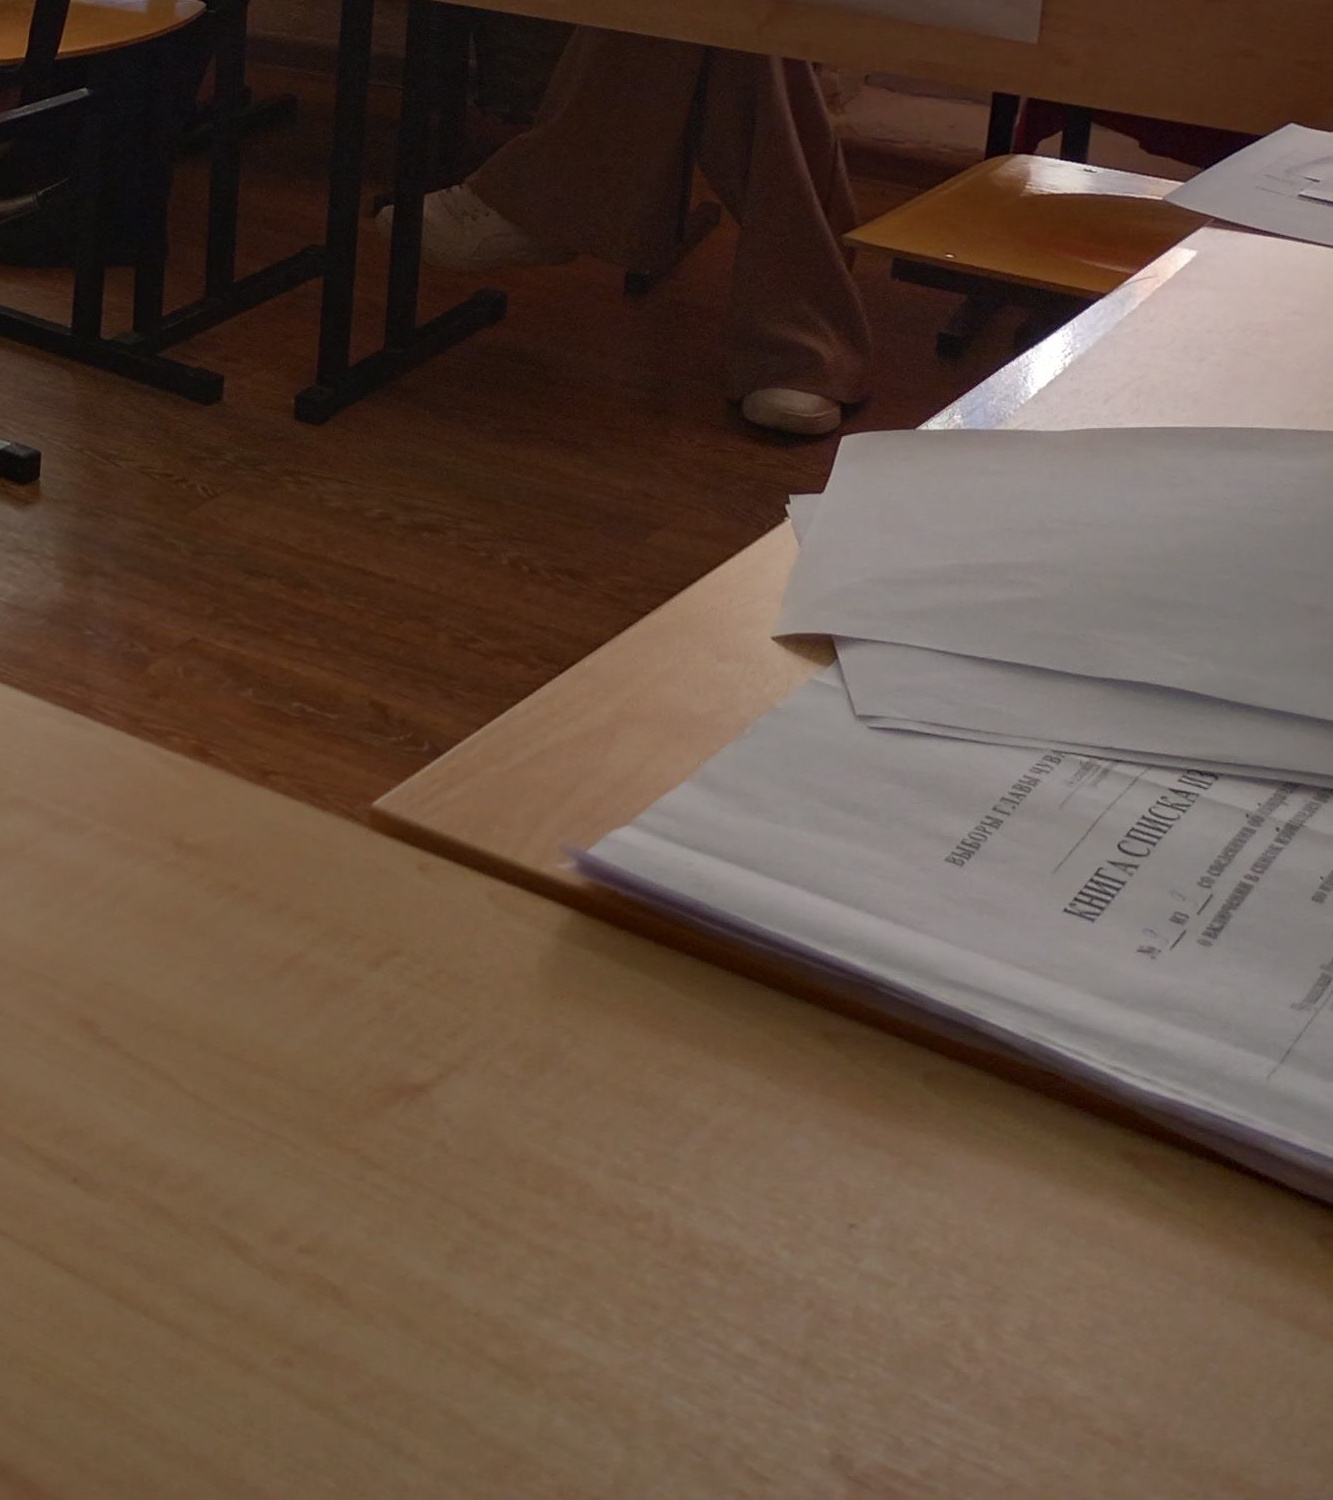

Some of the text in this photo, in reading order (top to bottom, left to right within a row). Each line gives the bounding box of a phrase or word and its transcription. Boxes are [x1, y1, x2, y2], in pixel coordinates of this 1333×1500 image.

[944, 814, 1004, 868] ВЫБОРЫ
[992, 774, 1041, 817] ГЛАВЫ
[1062, 859, 1141, 924] КНИГА
[1116, 787, 1201, 858] СПИСКА
